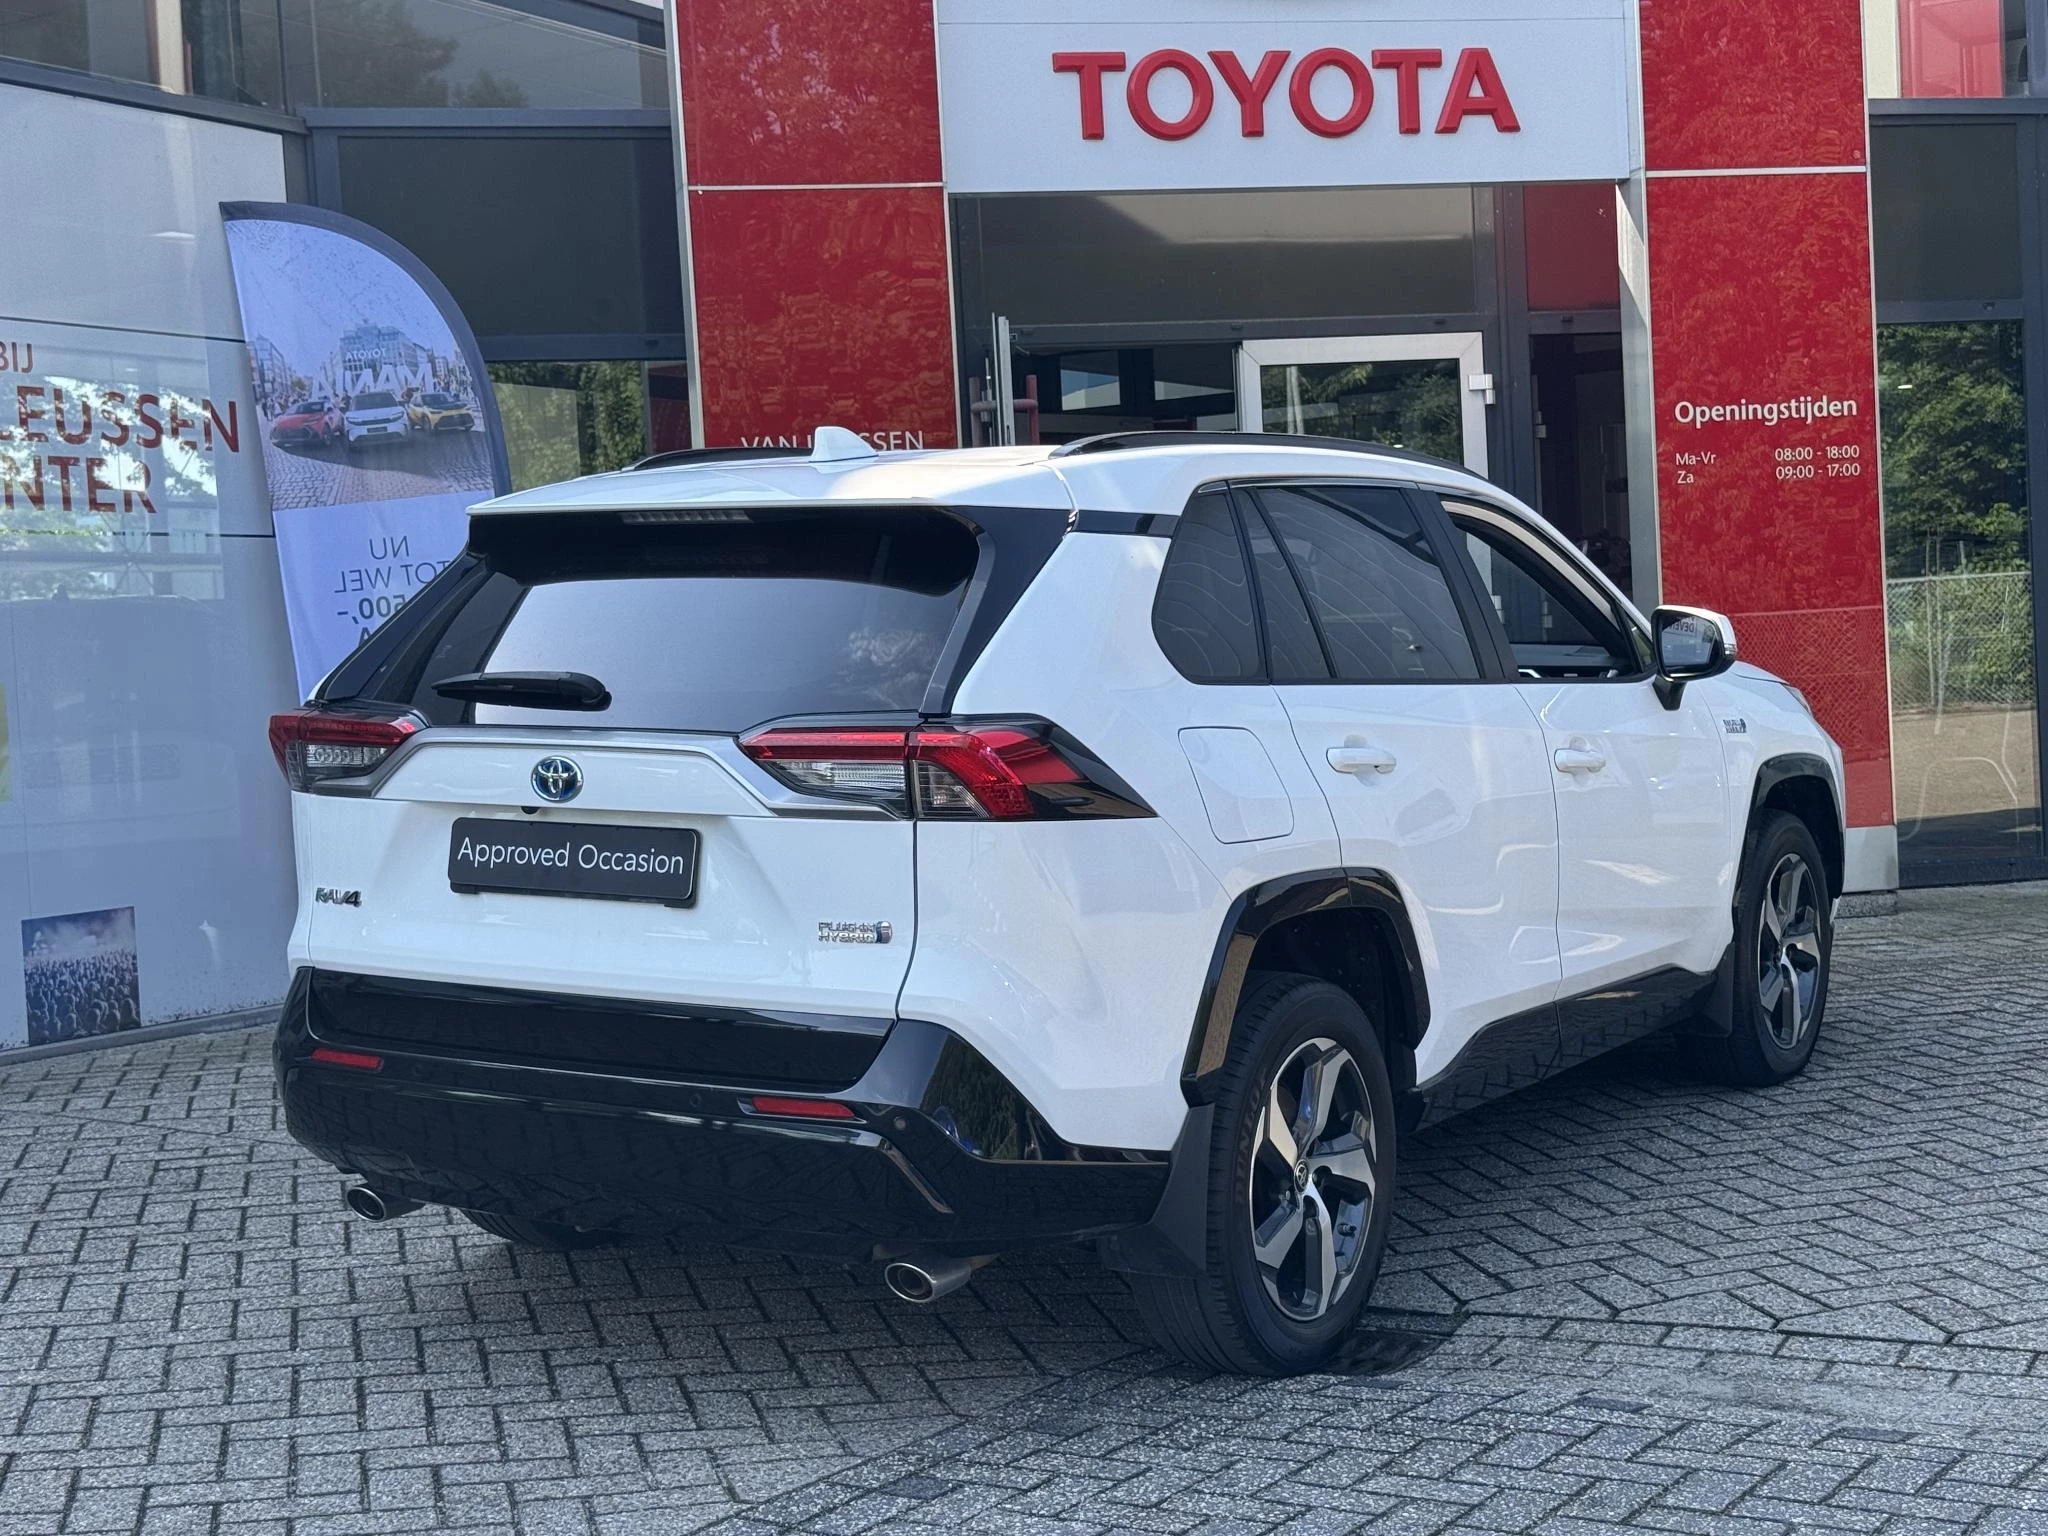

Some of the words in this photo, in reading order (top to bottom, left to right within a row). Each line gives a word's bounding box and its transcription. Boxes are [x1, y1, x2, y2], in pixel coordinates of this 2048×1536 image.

[1052, 47, 1521, 141] TOYOTA
[0, 385, 240, 453] EUSSEN
[1674, 395, 1857, 429] Openingstijden
[1675, 451, 1716, 466] Ma-Vr
[1775, 446, 1813, 462] 08:00
[1826, 445, 1860, 459] 18:00
[1677, 470, 1694, 484] Za
[1776, 465, 1815, 479] 09:00
[1828, 463, 1860, 477] 17:00
[457, 837, 569, 868] Approved
[579, 844, 684, 875] Occasion
